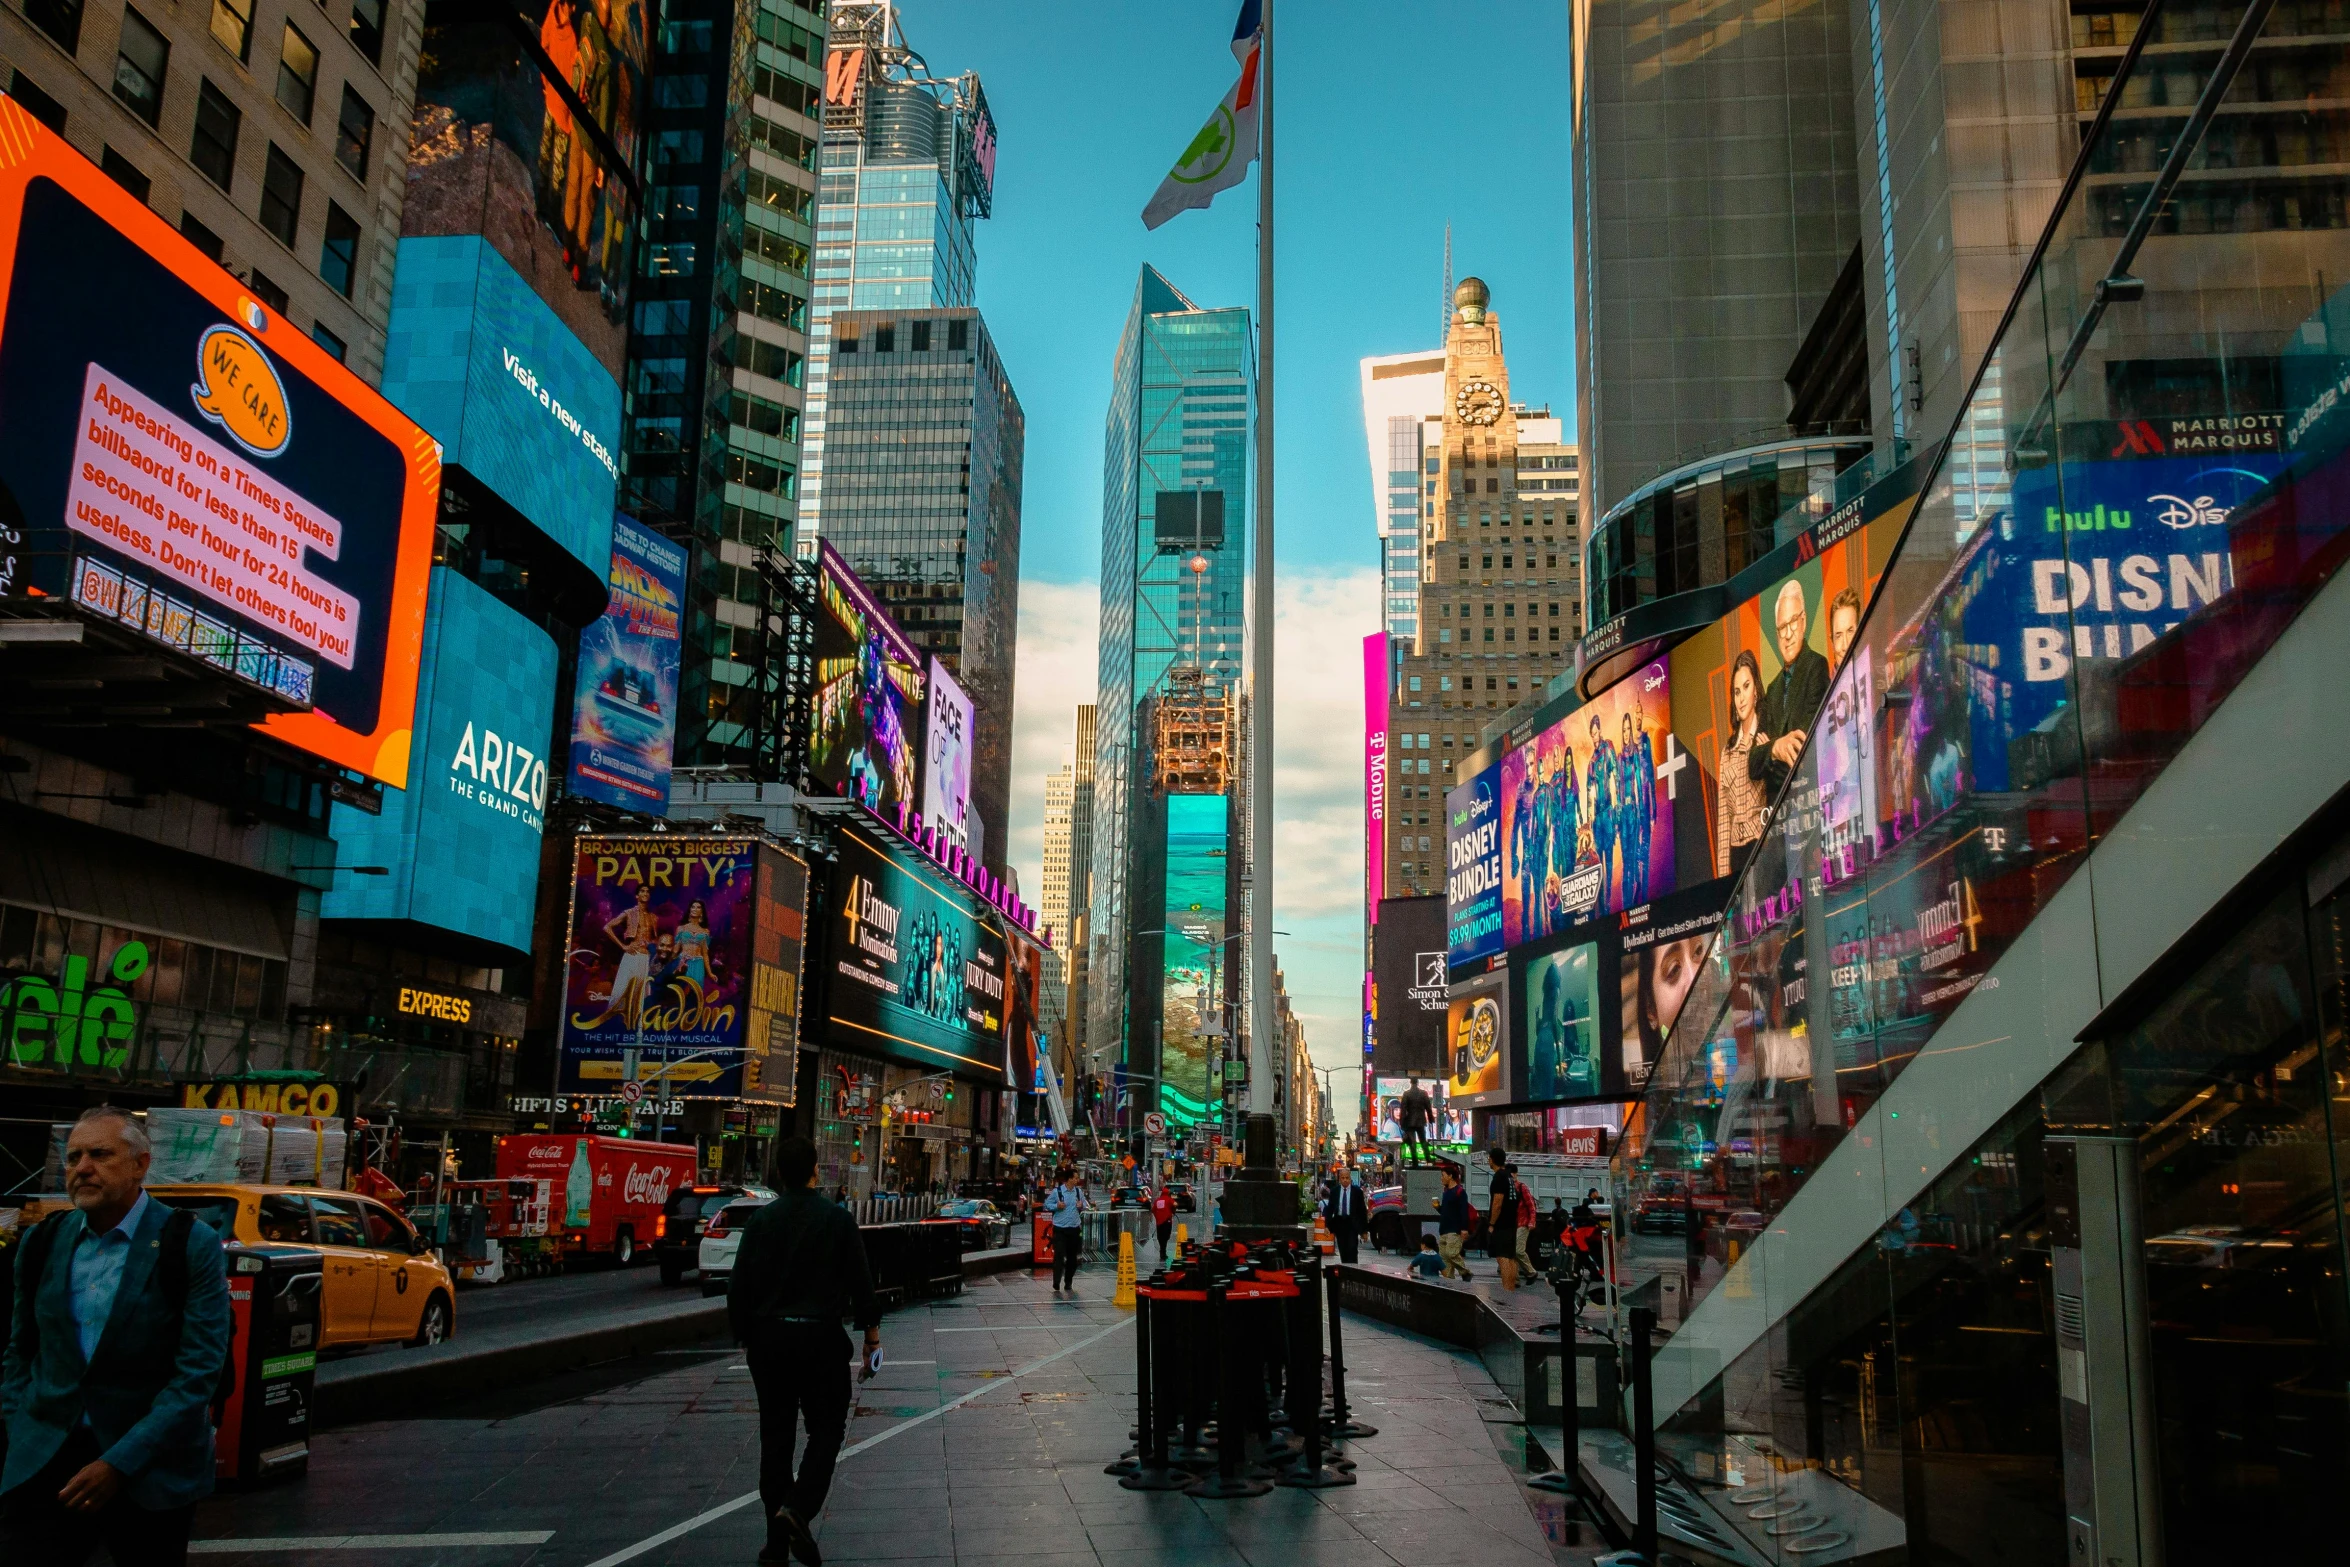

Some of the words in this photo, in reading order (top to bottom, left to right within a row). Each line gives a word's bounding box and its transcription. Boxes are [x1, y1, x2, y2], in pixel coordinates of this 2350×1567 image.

[212, 341, 241, 388] WE
[242, 383, 280, 437] CARE
[503, 347, 538, 397] Visit
[539, 388, 550, 408] a
[551, 399, 582, 437] new
[582, 429, 613, 472] state
[2172, 414, 2285, 433] MARRIOTT
[2174, 431, 2274, 450] MARQUIS
[94, 383, 193, 463] Appearing
[196, 451, 217, 475] on
[220, 466, 230, 484] a
[234, 469, 281, 513] Times
[283, 501, 335, 548] Square
[88, 418, 174, 487] billbaord
[177, 474, 202, 503] for
[205, 489, 238, 525] less
[242, 513, 277, 546] than
[281, 535, 298, 560] 15
[1818, 495, 1865, 535] MARRIOTT
[1818, 515, 1861, 550] MARQUIS
[2046, 504, 2132, 533] hulu
[82, 462, 165, 521] seconds
[167, 509, 198, 540] per
[201, 524, 240, 562] hour
[243, 549, 266, 573] for
[268, 564, 289, 590] 24
[291, 576, 332, 614] hours
[334, 599, 346, 622] is
[614, 532, 645, 557] ADWAY
[618, 523, 637, 540] TIME
[638, 534, 649, 547] TO
[649, 541, 681, 563] CHANGE
[76, 500, 156, 557] useless.
[160, 541, 208, 584] Don't
[211, 571, 233, 596] let
[235, 585, 286, 624] others
[289, 616, 317, 641] fool
[318, 629, 349, 657] you!
[2032, 552, 2236, 615] DISN
[619, 590, 679, 630] FUTURE
[1586, 616, 1627, 648] MARRIOTT
[1586, 633, 1621, 661] MARQUIS
[934, 684, 963, 744] FACE
[932, 729, 947, 766] OF
[451, 720, 549, 816] ARIZO
[450, 777, 474, 799] THE
[479, 790, 518, 818] GRAND
[1454, 809, 1468, 828] hulu
[582, 842, 681, 856] BROADWAY'S
[684, 842, 751, 856] BIGGEST
[1452, 819, 1498, 870] DISNEY
[596, 856, 736, 887] PARTY!
[954, 844, 1037, 932] BROADWAY
[1450, 855, 1499, 906] BUNDLE
[1562, 869, 1600, 897] GUARDIANS
[844, 874, 860, 945] 4
[861, 878, 900, 947] Emmy
[1454, 908, 1467, 923] PLANS
[1468, 899, 1489, 918] STARTING
[1489, 896, 1495, 909] AT
[1569, 887, 1597, 906] GALAXY
[859, 926, 898, 964] Nominations
[1449, 910, 1502, 949] $9.99/MONTH
[1674, 924, 1686, 935] Best
[839, 961, 869, 983] OUTSTANDING
[869, 973, 885, 989] COMEDY
[885, 980, 899, 994] SERIES
[966, 961, 984, 991] JURY
[985, 972, 1003, 1000] DUTY
[1408, 987, 1440, 1000] Simon
[399, 988, 471, 1023] EXPRESS
[571, 975, 736, 1032] Aladdin
[1421, 998, 1449, 1010] Schus
[570, 1047, 591, 1055] YOUR
[594, 1047, 615, 1055] WISH
[670, 1048, 676, 1056] 4
[584, 1032, 602, 1042] THE
[603, 1032, 620, 1042] HIT
[622, 1033, 679, 1043] BRADWAY
[680, 1033, 723, 1044] MUSICAL
[182, 1083, 339, 1117] KAMCO
[584, 1098, 685, 1116] LUAGE
[1387, 1290, 1411, 1312] SQUARE
[263, 1361, 286, 1375] TIMES
[286, 1355, 315, 1371] SQUARE
